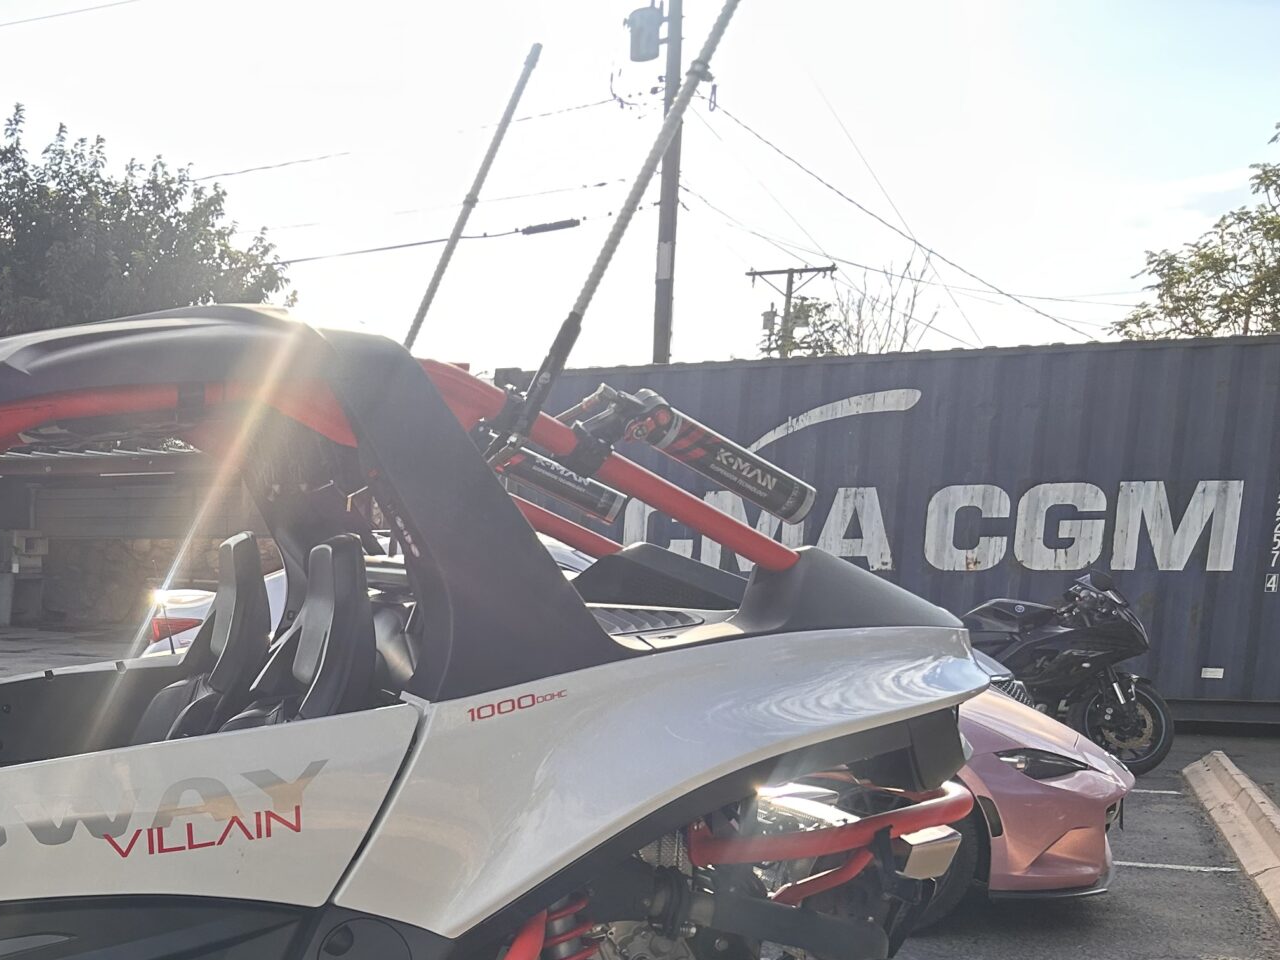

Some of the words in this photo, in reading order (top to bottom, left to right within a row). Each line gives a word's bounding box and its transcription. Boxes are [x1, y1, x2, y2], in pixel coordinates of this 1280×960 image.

[924, 480, 1244, 571] CGM
[1266, 574, 1278, 592] 4
[103, 804, 302, 858] VILLAIN
